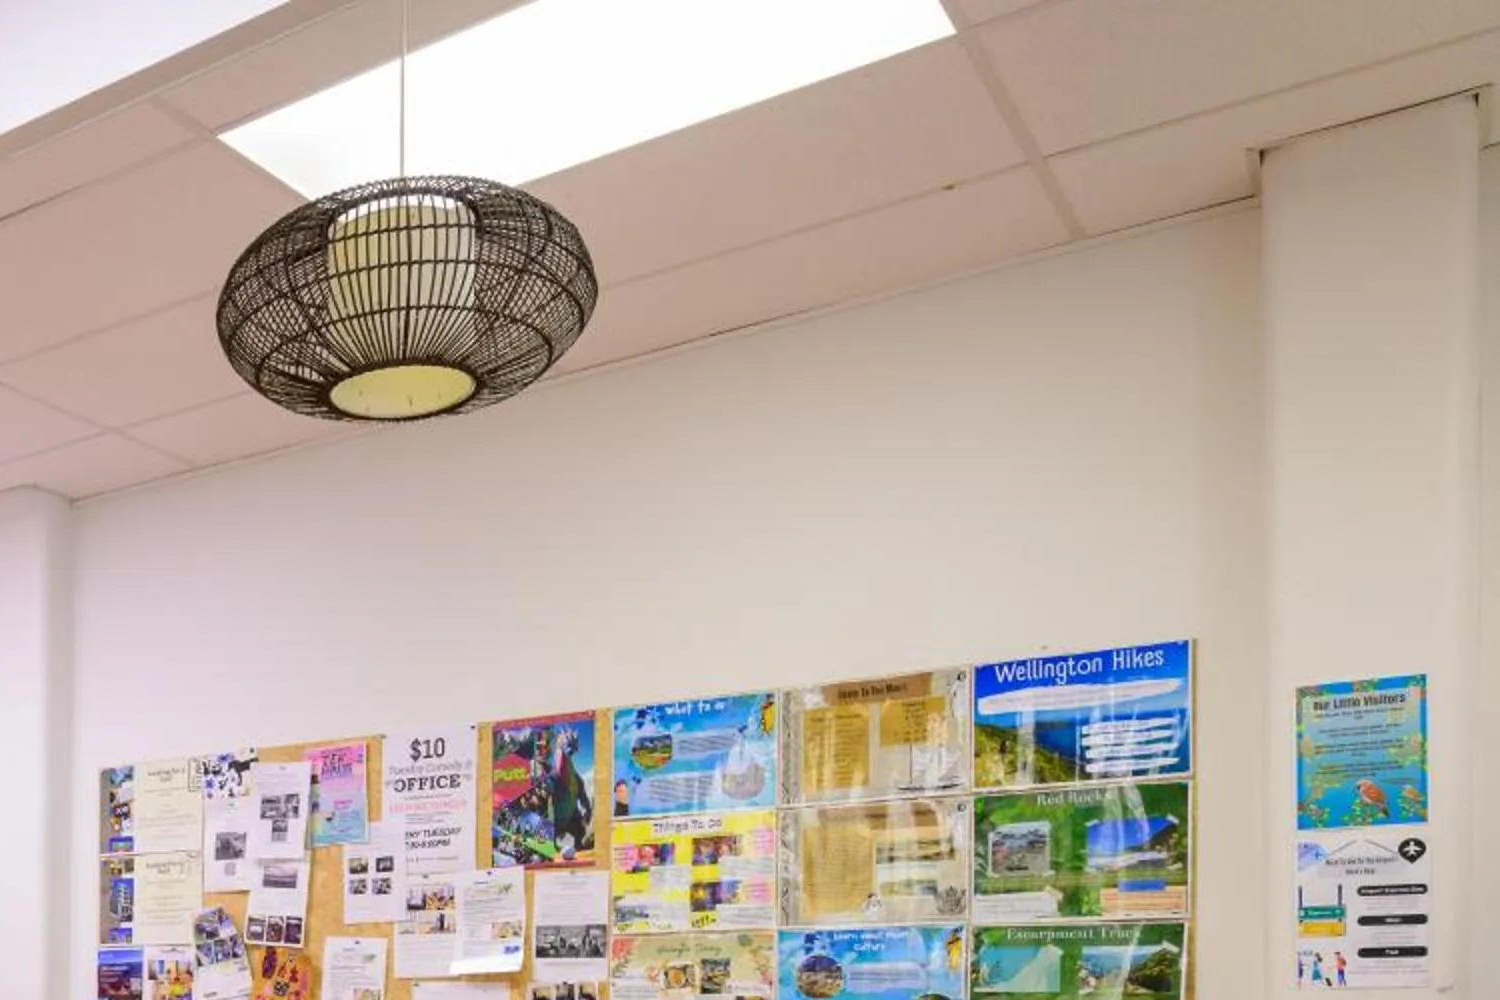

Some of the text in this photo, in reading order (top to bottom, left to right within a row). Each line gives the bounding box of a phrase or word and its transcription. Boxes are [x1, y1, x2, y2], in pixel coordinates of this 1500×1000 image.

[994, 649, 1165, 686] Wellington Hikes
[1333, 696, 1361, 710] Little
[1362, 692, 1407, 706] Visitors
[409, 737, 446, 763] $10
[393, 773, 462, 793] OFFICE
[1006, 926, 1096, 942] Escarpment
